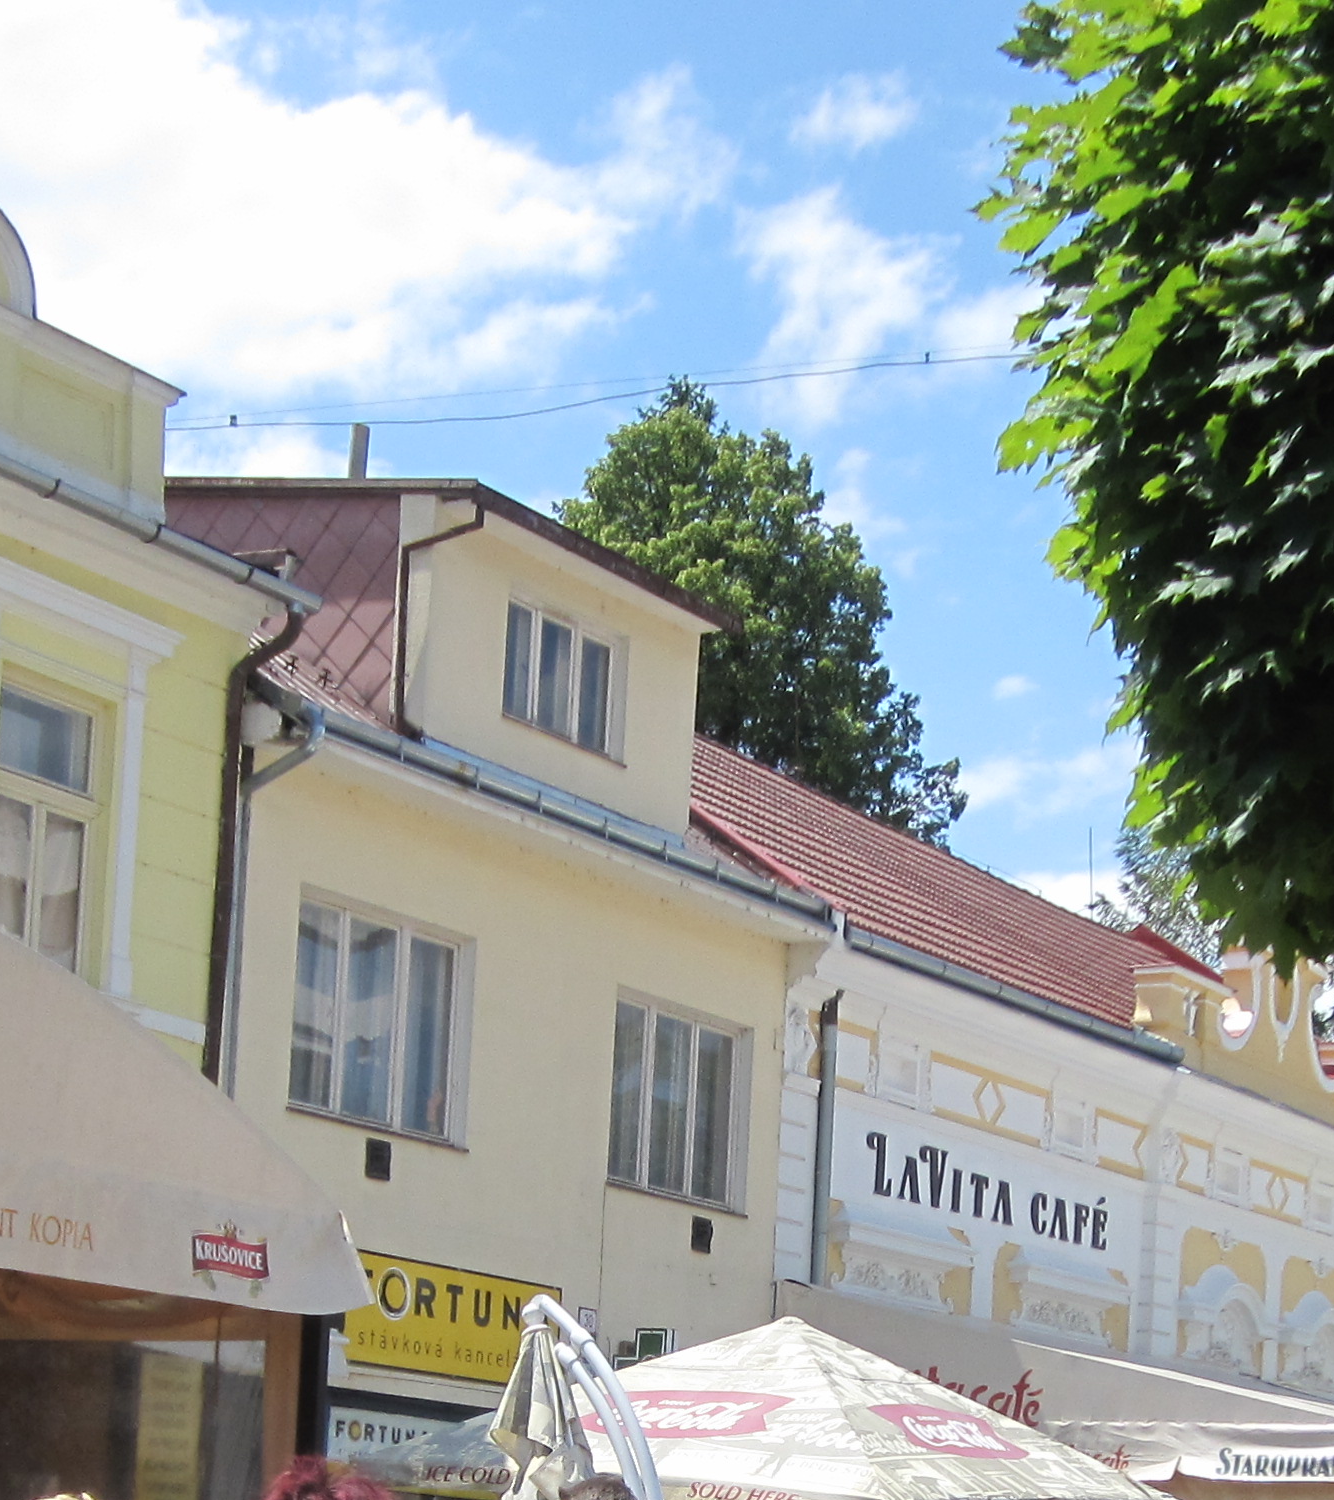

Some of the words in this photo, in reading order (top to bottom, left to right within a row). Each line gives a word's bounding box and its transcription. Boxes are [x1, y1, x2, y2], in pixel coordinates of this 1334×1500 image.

[29, 1212, 95, 1252] KOPIA
[1029, 1191, 1109, 1251] CAFÉ
[194, 1236, 265, 1272] KRUŠOVICE
[366, 1267, 545, 1331] ORTUN
[357, 1329, 444, 1358] stávková
[334, 1419, 430, 1445] FORTUN
[424, 1464, 453, 1482] ICE
[458, 1466, 511, 1486] COLD
[687, 1480, 743, 1500] SOLD
